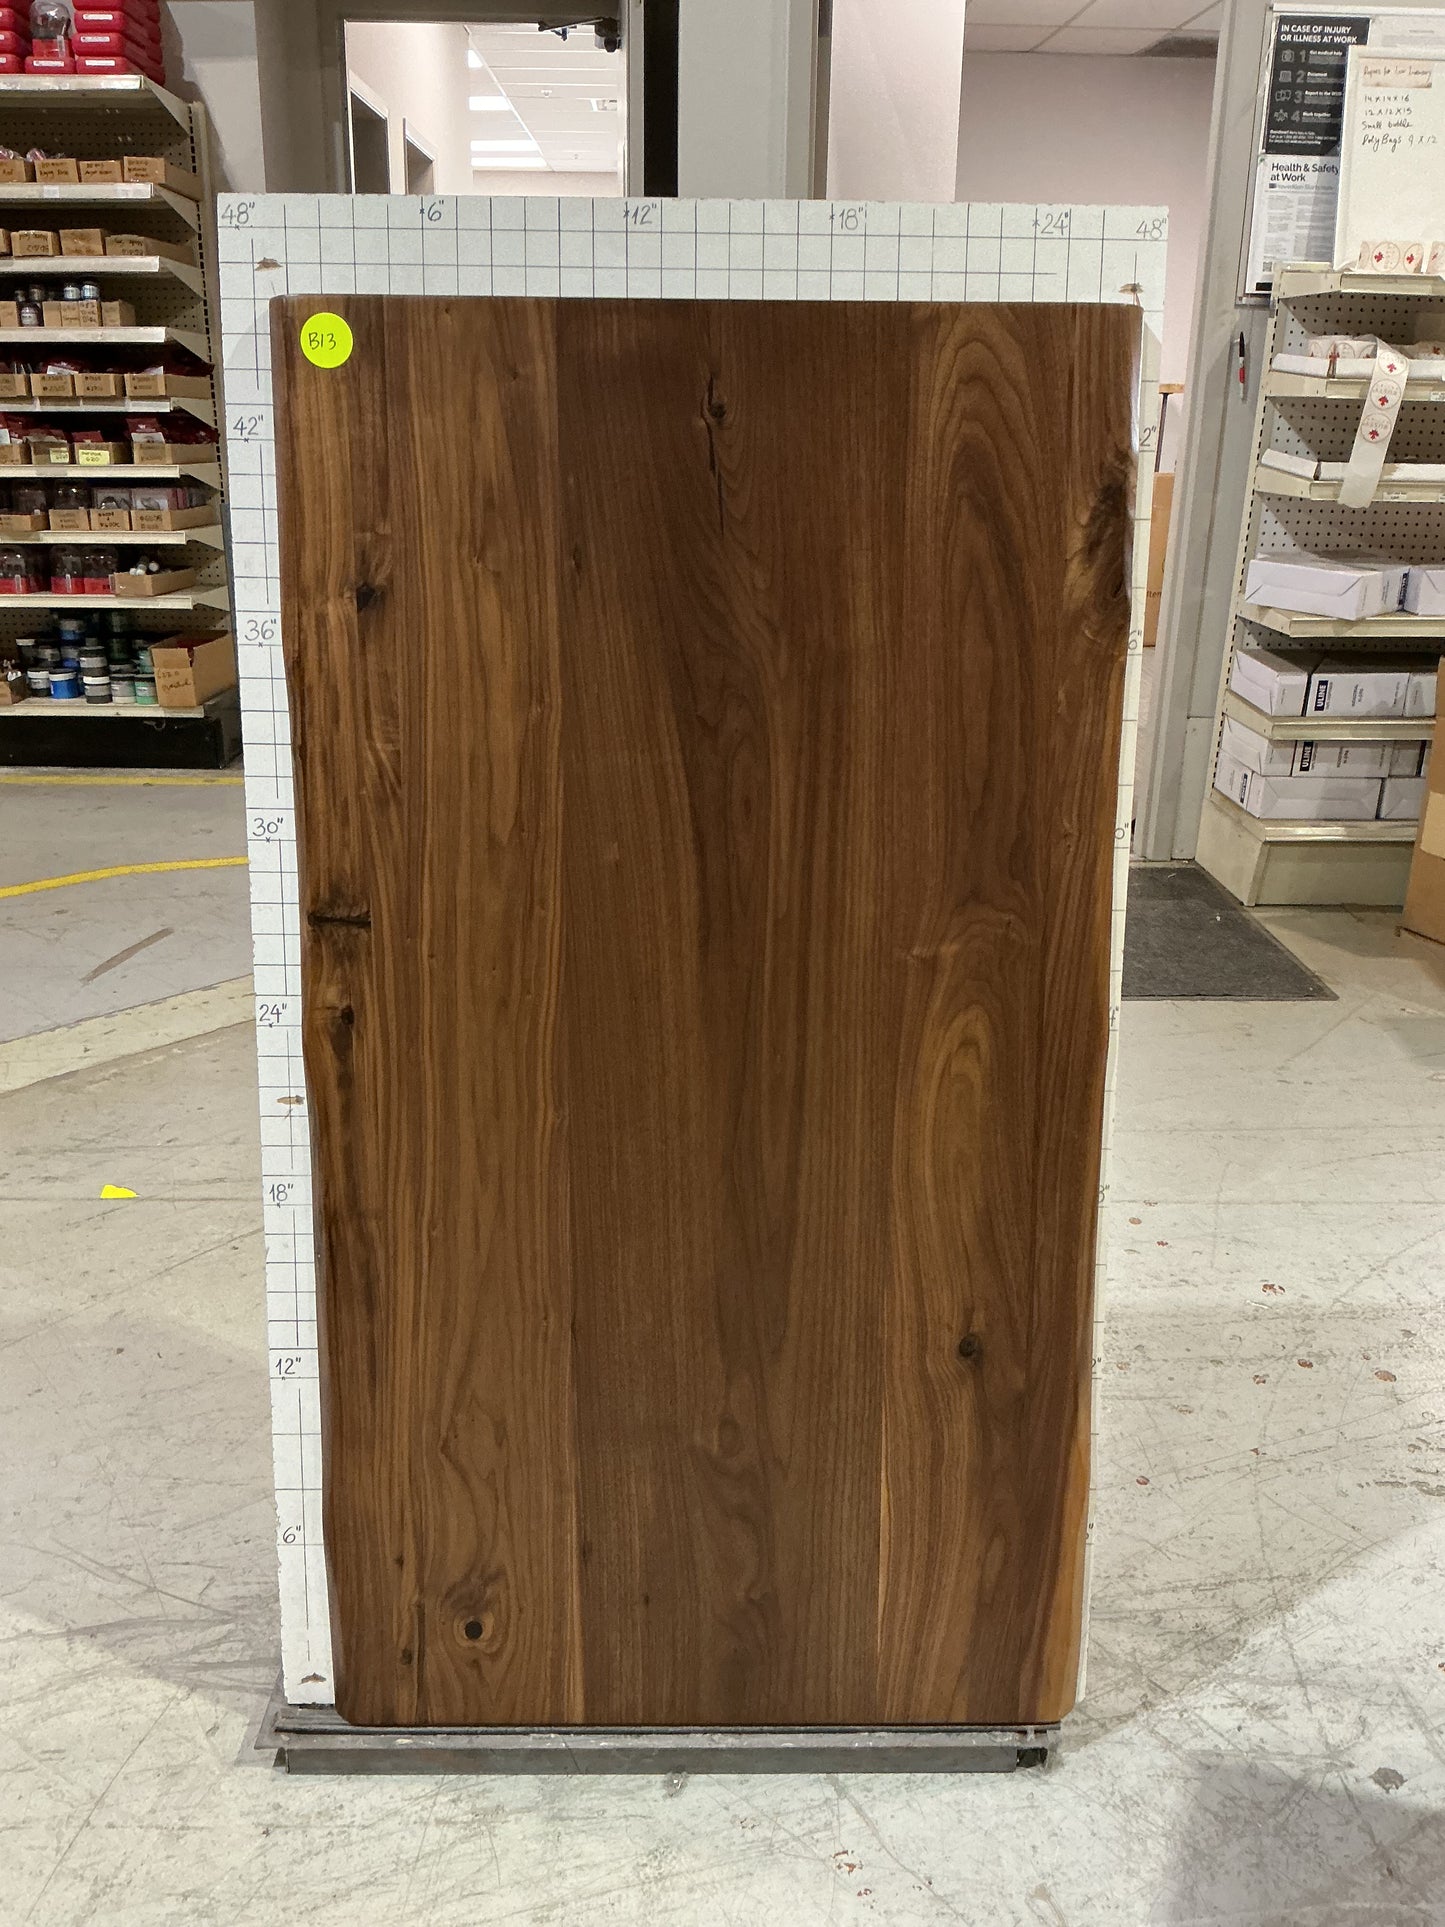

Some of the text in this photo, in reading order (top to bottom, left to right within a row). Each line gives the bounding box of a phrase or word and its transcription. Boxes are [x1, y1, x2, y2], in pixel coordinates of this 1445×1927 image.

[1280, 34, 1358, 44] OR ILLNESS AT WORK
[1281, 24, 1352, 34] IN CASE OF INJURY
[1270, 172, 1306, 182] at Work
[1271, 162, 1339, 176] Health & Safety
[221, 201, 256, 225] 48"
[427, 199, 445, 222] 6"
[630, 203, 658, 226] 12"
[839, 206, 864, 231] 18"
[1041, 211, 1069, 236] 24"
[1135, 217, 1168, 240] 48"
[307, 331, 337, 351] B13
[232, 414, 264, 437] 42"
[244, 618, 278, 641] 36"
[1316, 684, 1327, 707] ULINE
[1302, 746, 1312, 768] ULINE
[252, 816, 284, 837] 30"
[258, 1002, 288, 1024] 24"
[269, 1183, 294, 1202] 18"
[275, 1356, 302, 1376] 12"
[282, 1524, 302, 1544] 6"
